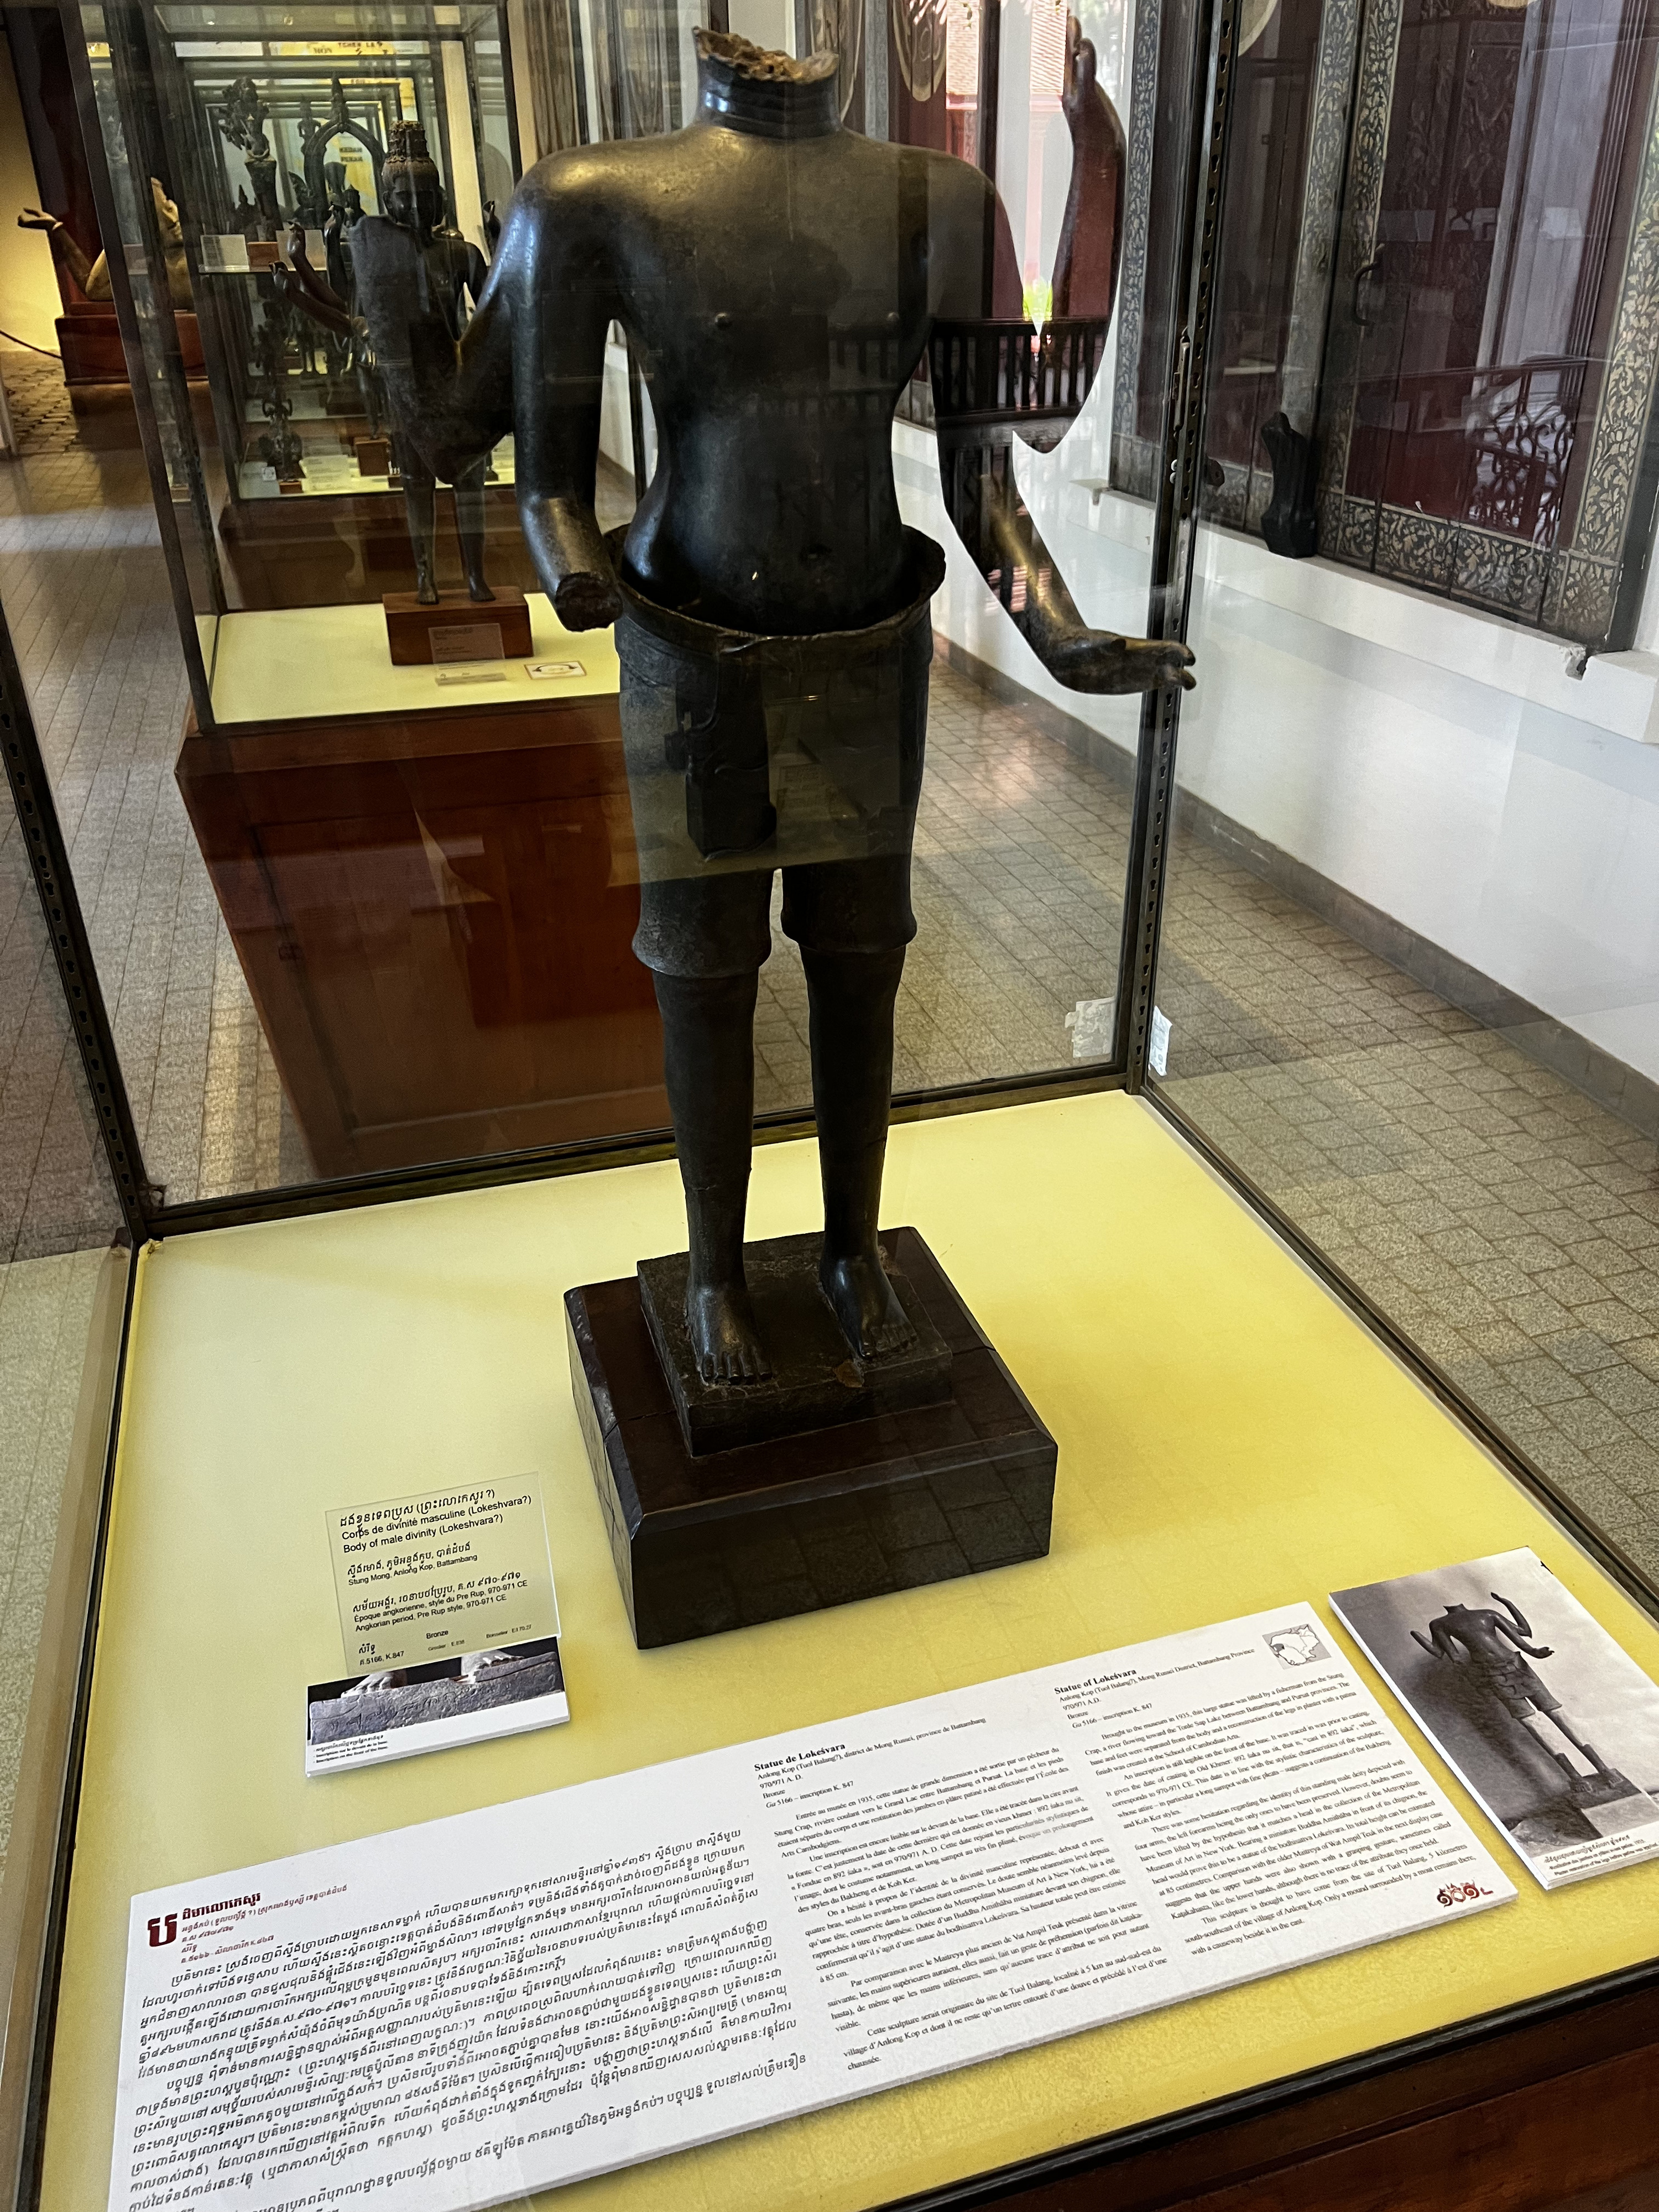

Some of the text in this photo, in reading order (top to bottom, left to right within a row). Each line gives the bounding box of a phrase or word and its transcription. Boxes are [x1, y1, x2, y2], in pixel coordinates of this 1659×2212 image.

[341, 1494, 532, 1541] Corps de divinité masculine (Lokeshvara?)
[343, 1513, 503, 1554] Body of male divinity (Lokeshvara?)
[348, 1554, 478, 1586] Stung Mong, Anlong Kop, Battambang
[353, 1579, 528, 1624] Époque angkorienne, style du Pre Rup, 970-971 CE
[355, 1593, 508, 1632] Angkorian period, Pre Rup style, 970-971 CE
[425, 1630, 449, 1640] Bronze
[385, 1650, 405, 1660] K.847
[1053, 1669, 1138, 1695] Statue of Lokeśvara
[1059, 1693, 1082, 1703] Anlong
[1094, 1684, 1111, 1694] (Tuol
[1137, 1674, 1156, 1682] Mong
[1173, 1663, 1198, 1673] District,
[1196, 1655, 1232, 1667] Battambang
[1229, 1648, 1255, 1658] Province
[1067, 1710, 1089, 1720] Bronze
[1082, 1717, 1098, 1726] 5166
[1102, 1709, 1134, 1721] inscription
[1140, 1702, 1152, 1710] 847
[753, 1744, 846, 1772] Statue de Lokeśvara
[757, 1770, 781, 1781] Anlong
[795, 1760, 813, 1771] (Tuol
[843, 1748, 865, 1758] district
[873, 1741, 894, 1750] Mong
[915, 1729, 942, 1741] province
[950, 1718, 987, 1731] Battambang
[759, 1778, 785, 1790] 970/971
[762, 1789, 786, 1799] Bronze
[776, 1796, 794, 1806] 5166
[799, 1787, 833, 1800] inscription
[841, 1780, 854, 1789] 847
[1123, 1820, 1136, 1829] and
[1134, 1817, 1150, 1826] Koh
[781, 1839, 842, 1859] Arts Cambodgiens.
[1191, 1945, 1207, 1955] with
[1212, 1936, 1243, 1950] causeway
[1242, 1929, 1265, 1940] beside
[1289, 1918, 1306, 1927] east.
[825, 1973, 835, 1981] 85
[834, 2020, 862, 2032] visible.
